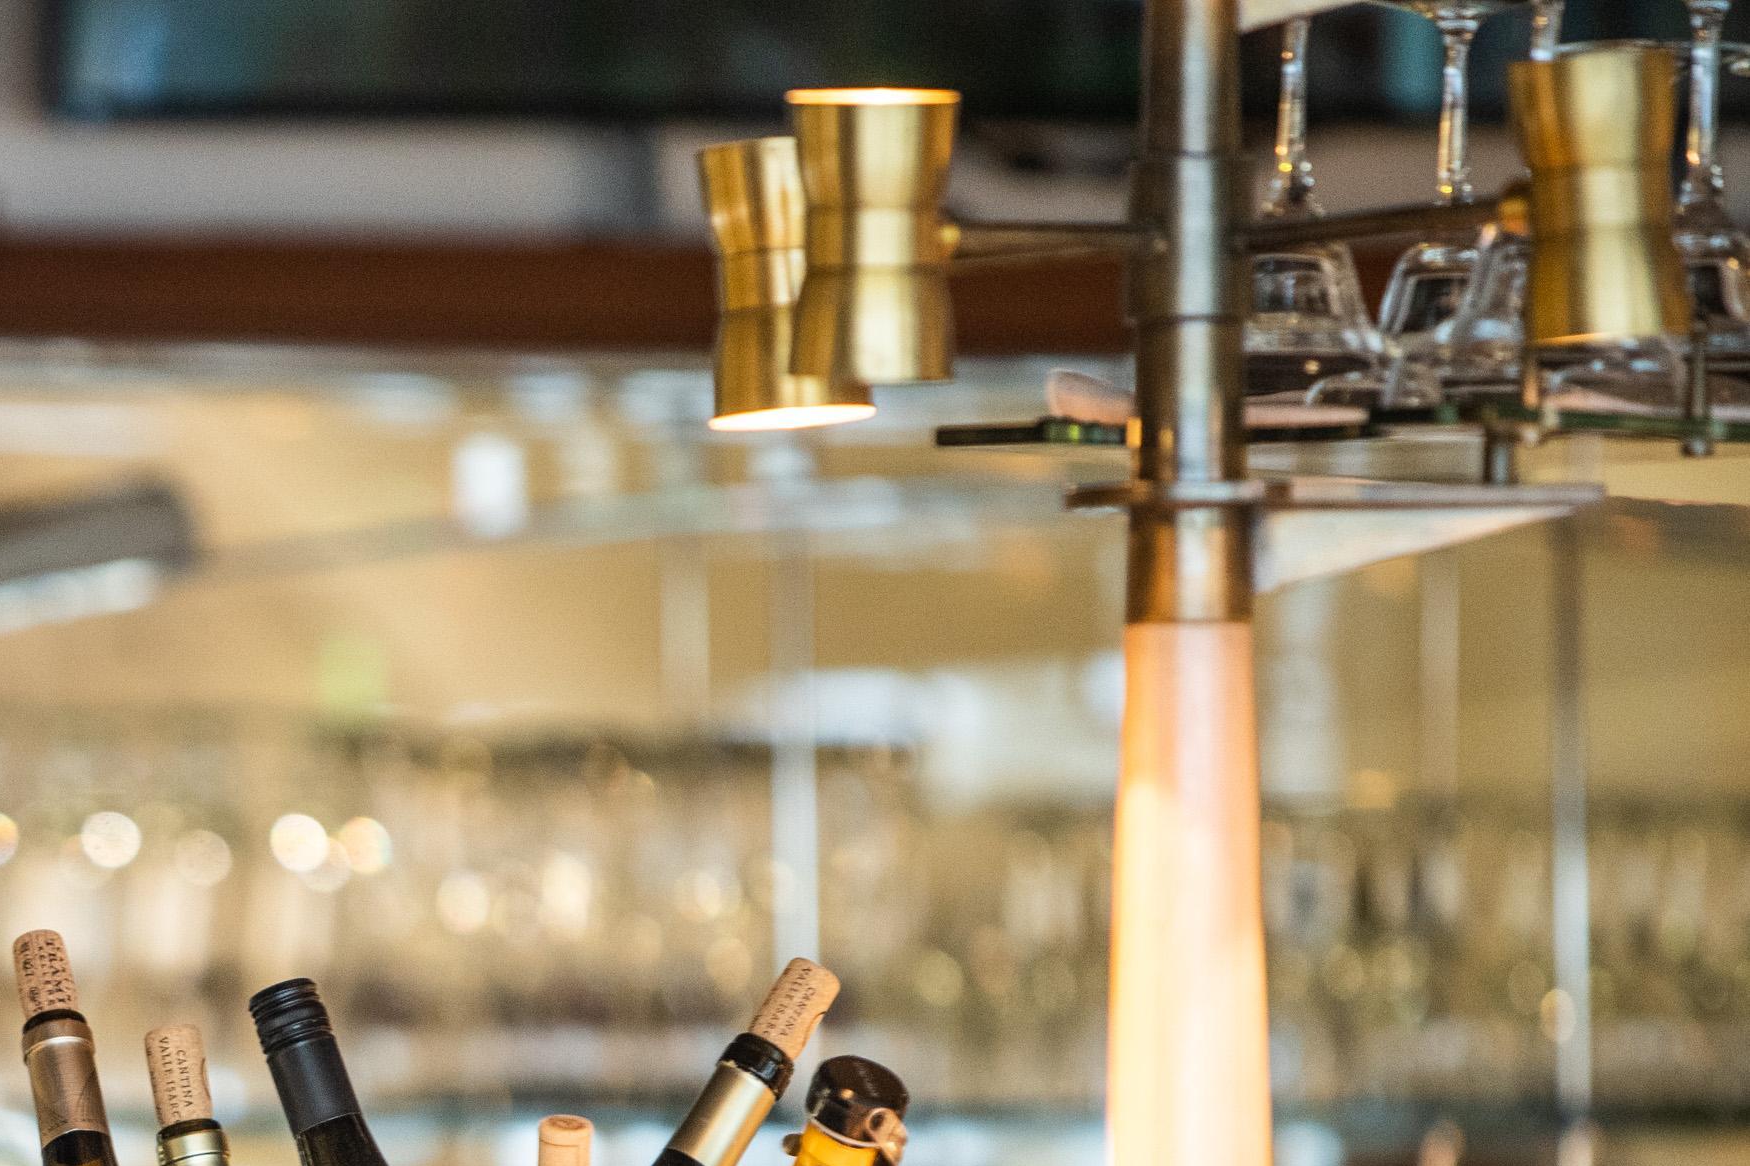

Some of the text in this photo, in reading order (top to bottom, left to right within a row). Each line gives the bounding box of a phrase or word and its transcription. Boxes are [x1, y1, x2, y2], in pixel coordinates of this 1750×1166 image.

[763, 1003, 788, 1035] ISARC
[780, 986, 816, 1036] CANTINA
[158, 1036, 173, 1078] VALLE
[176, 1049, 193, 1109] CANTINA
